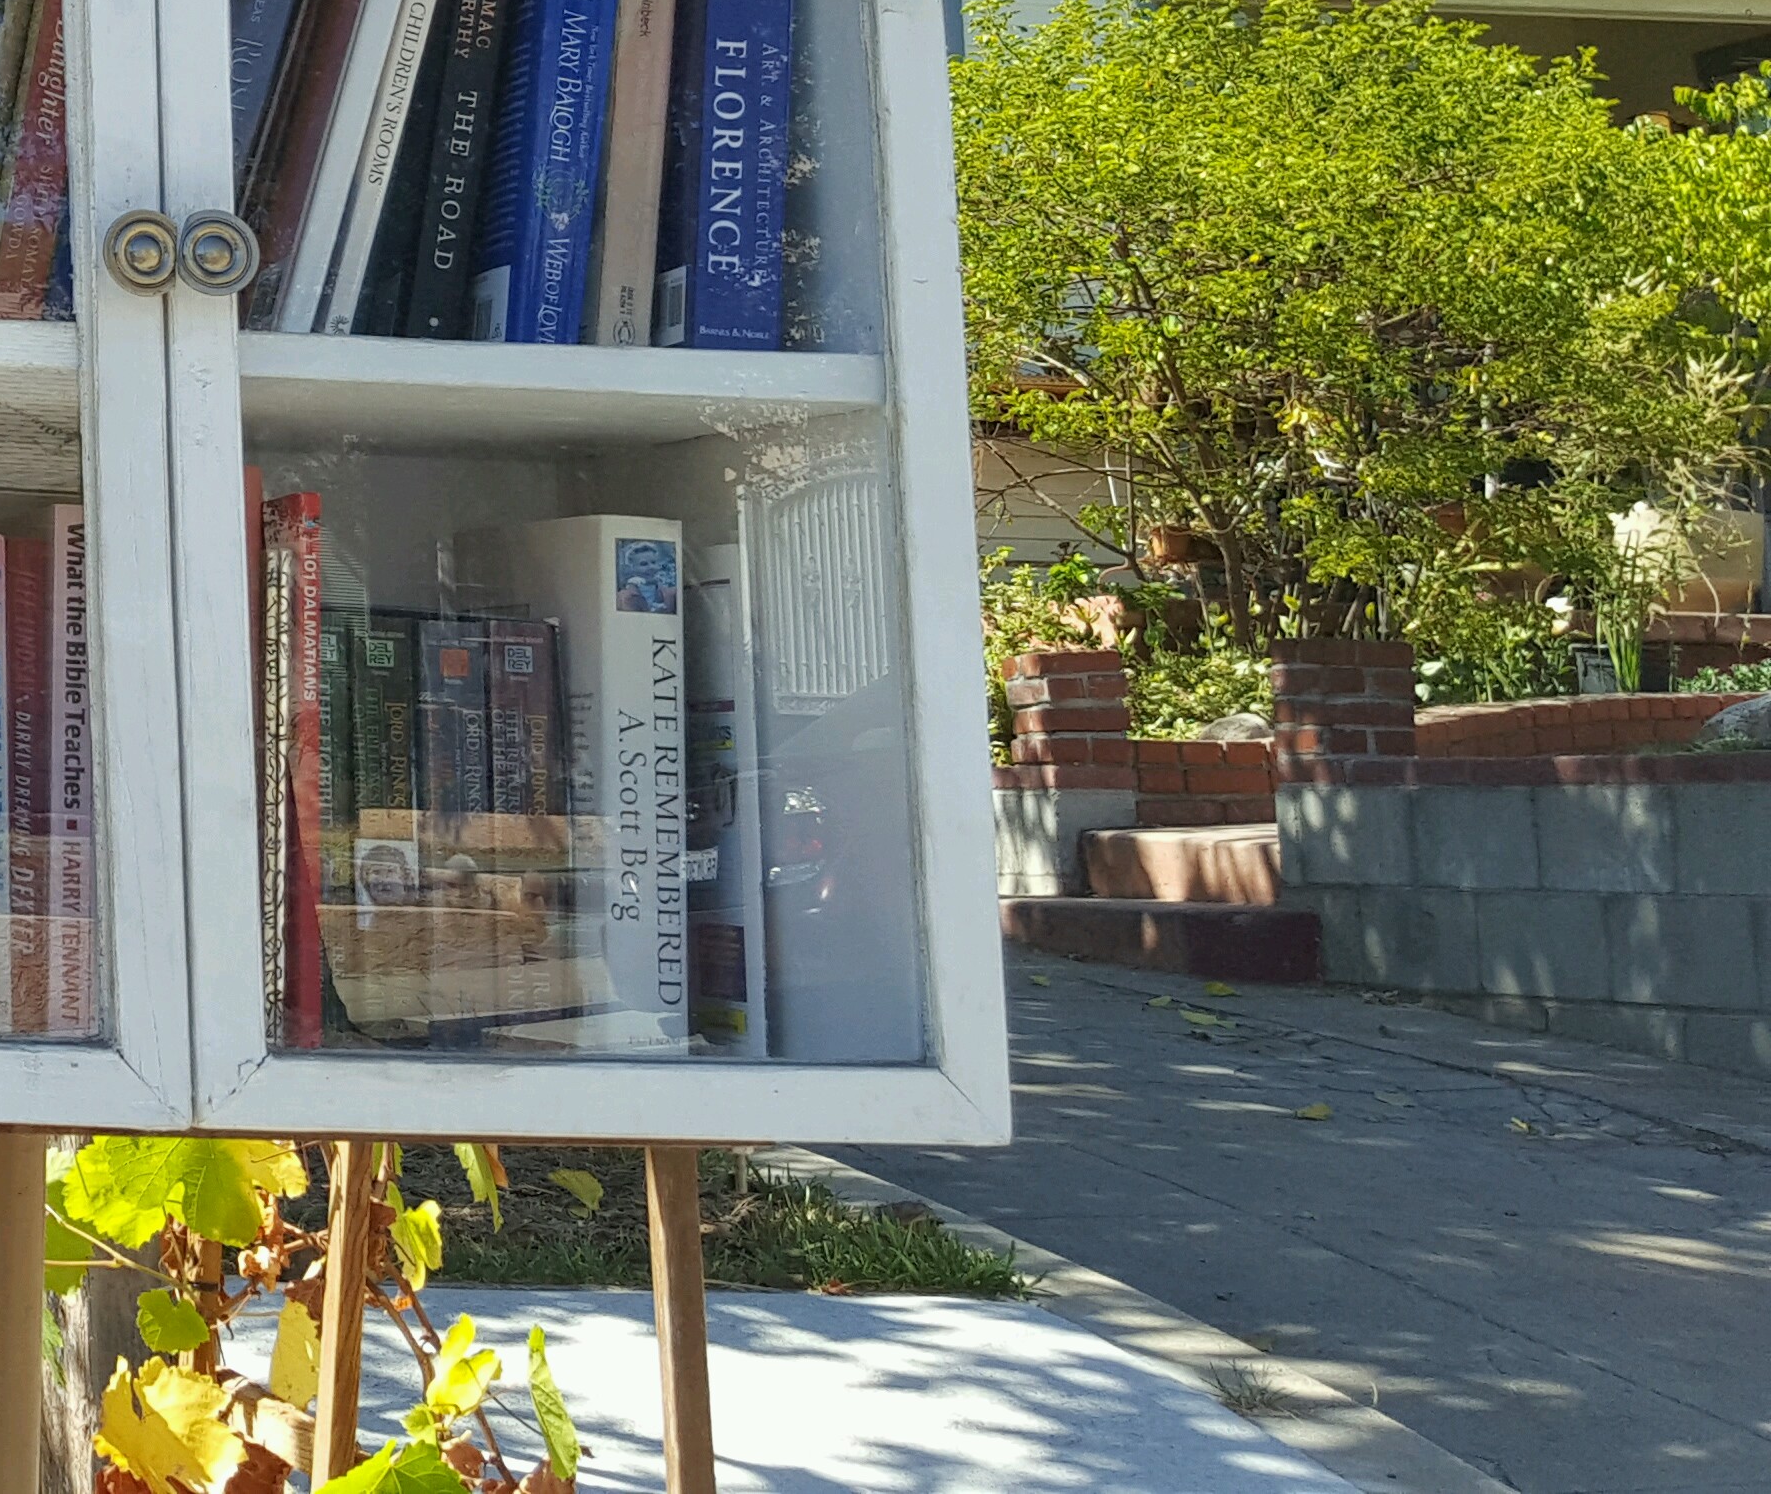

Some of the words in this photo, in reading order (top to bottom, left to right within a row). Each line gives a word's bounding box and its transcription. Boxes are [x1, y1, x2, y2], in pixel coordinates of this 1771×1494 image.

[382, 0, 428, 115] CHILDREN'S
[556, 8, 590, 74] MARY
[368, 117, 398, 187] ROOMS
[449, 89, 479, 157] THE
[548, 75, 583, 163] BALOGH
[707, 38, 748, 275] FLORENCE
[433, 172, 466, 271] ROAD
[66, 522, 87, 591] What
[303, 551, 319, 579] 101
[65, 595, 87, 637] the
[303, 582, 319, 704] DALMATIANS
[65, 640, 87, 706] Bible
[651, 635, 679, 733] KATE
[14, 710, 32, 769] DARKLY
[63, 707, 87, 810] Teaches
[618, 707, 646, 743] A.
[14, 772, 32, 857] DREAMING
[618, 749, 648, 836] Scott
[62, 840, 82, 914] HARRY
[611, 846, 648, 922] Berg
[653, 743, 683, 1007] REMEMBERED
[60, 919, 81, 1025] TENNANT
